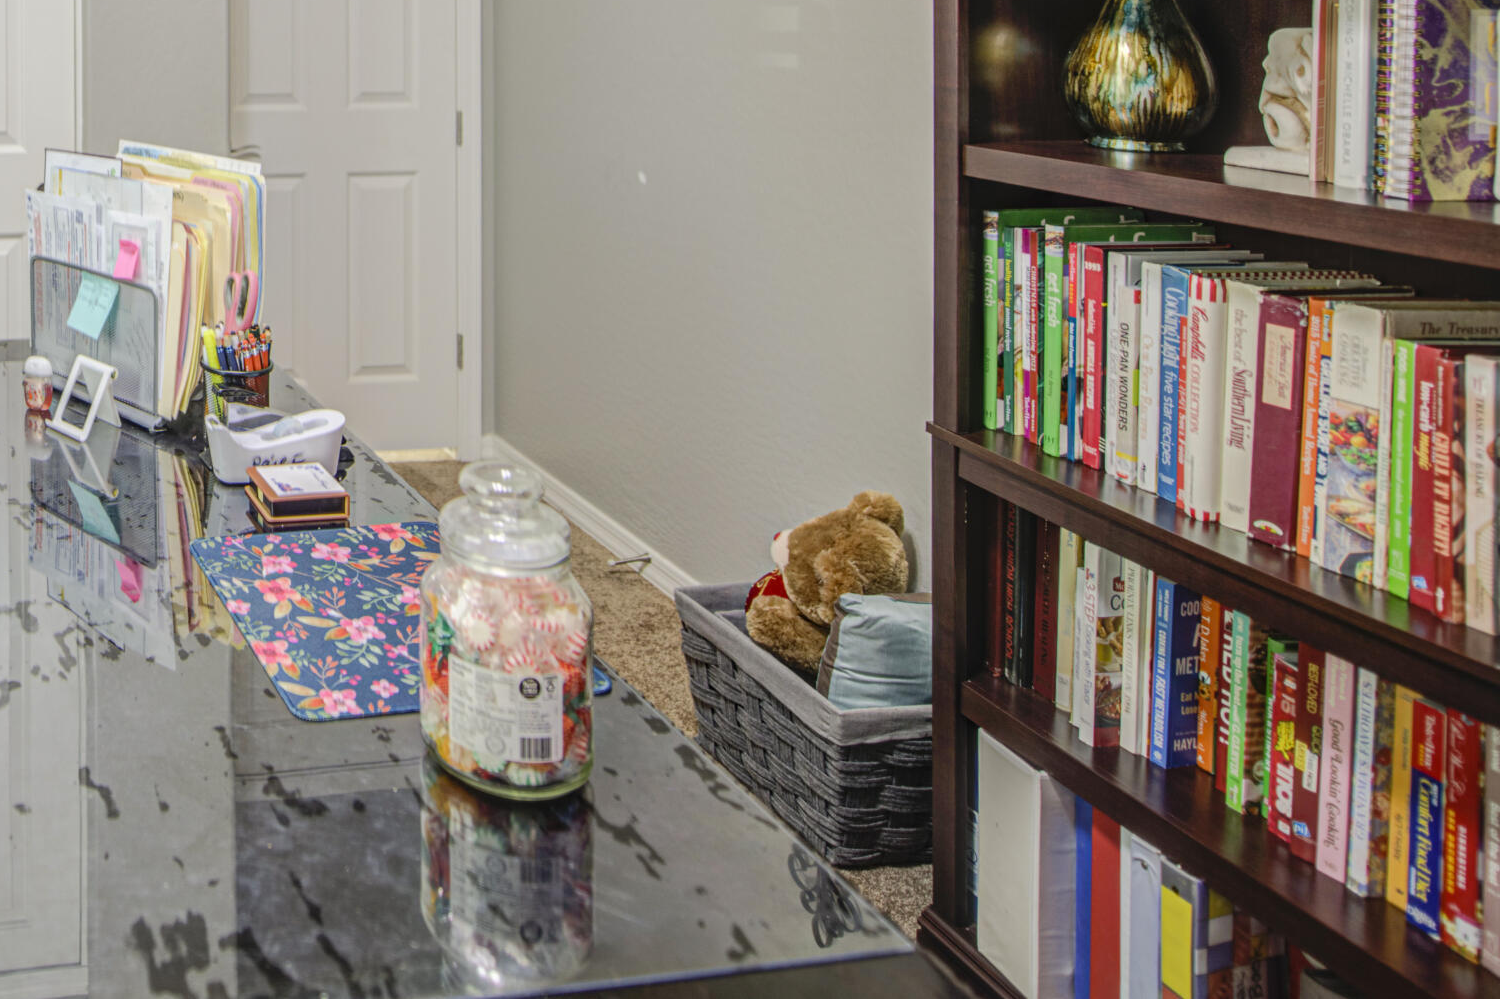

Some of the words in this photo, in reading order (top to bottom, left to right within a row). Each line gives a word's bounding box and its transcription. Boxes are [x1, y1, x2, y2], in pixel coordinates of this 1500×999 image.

[1342, 61, 1354, 120] MICHELLE
[1341, 122, 1352, 165] OBAMA
[985, 277, 997, 307] fresh
[1046, 272, 1059, 292] get
[1047, 296, 1061, 328] fresh
[1420, 321, 1443, 336] The
[1119, 322, 1130, 372] ONE-PAN
[1164, 370, 1176, 394] five
[1118, 375, 1129, 432] WONDERS
[1163, 395, 1174, 421] star
[1419, 380, 1435, 432] low-carb
[1159, 421, 1173, 466] recipes
[1414, 432, 1433, 471] magic
[1434, 431, 1451, 477] GRILL
[1433, 479, 1451, 501] IT
[1153, 697, 1165, 749] METABOLISM
[1329, 718, 1345, 753] Good
[1418, 778, 1433, 835] Comfort
[1416, 834, 1432, 872] Food
[1415, 871, 1430, 904] Diet
